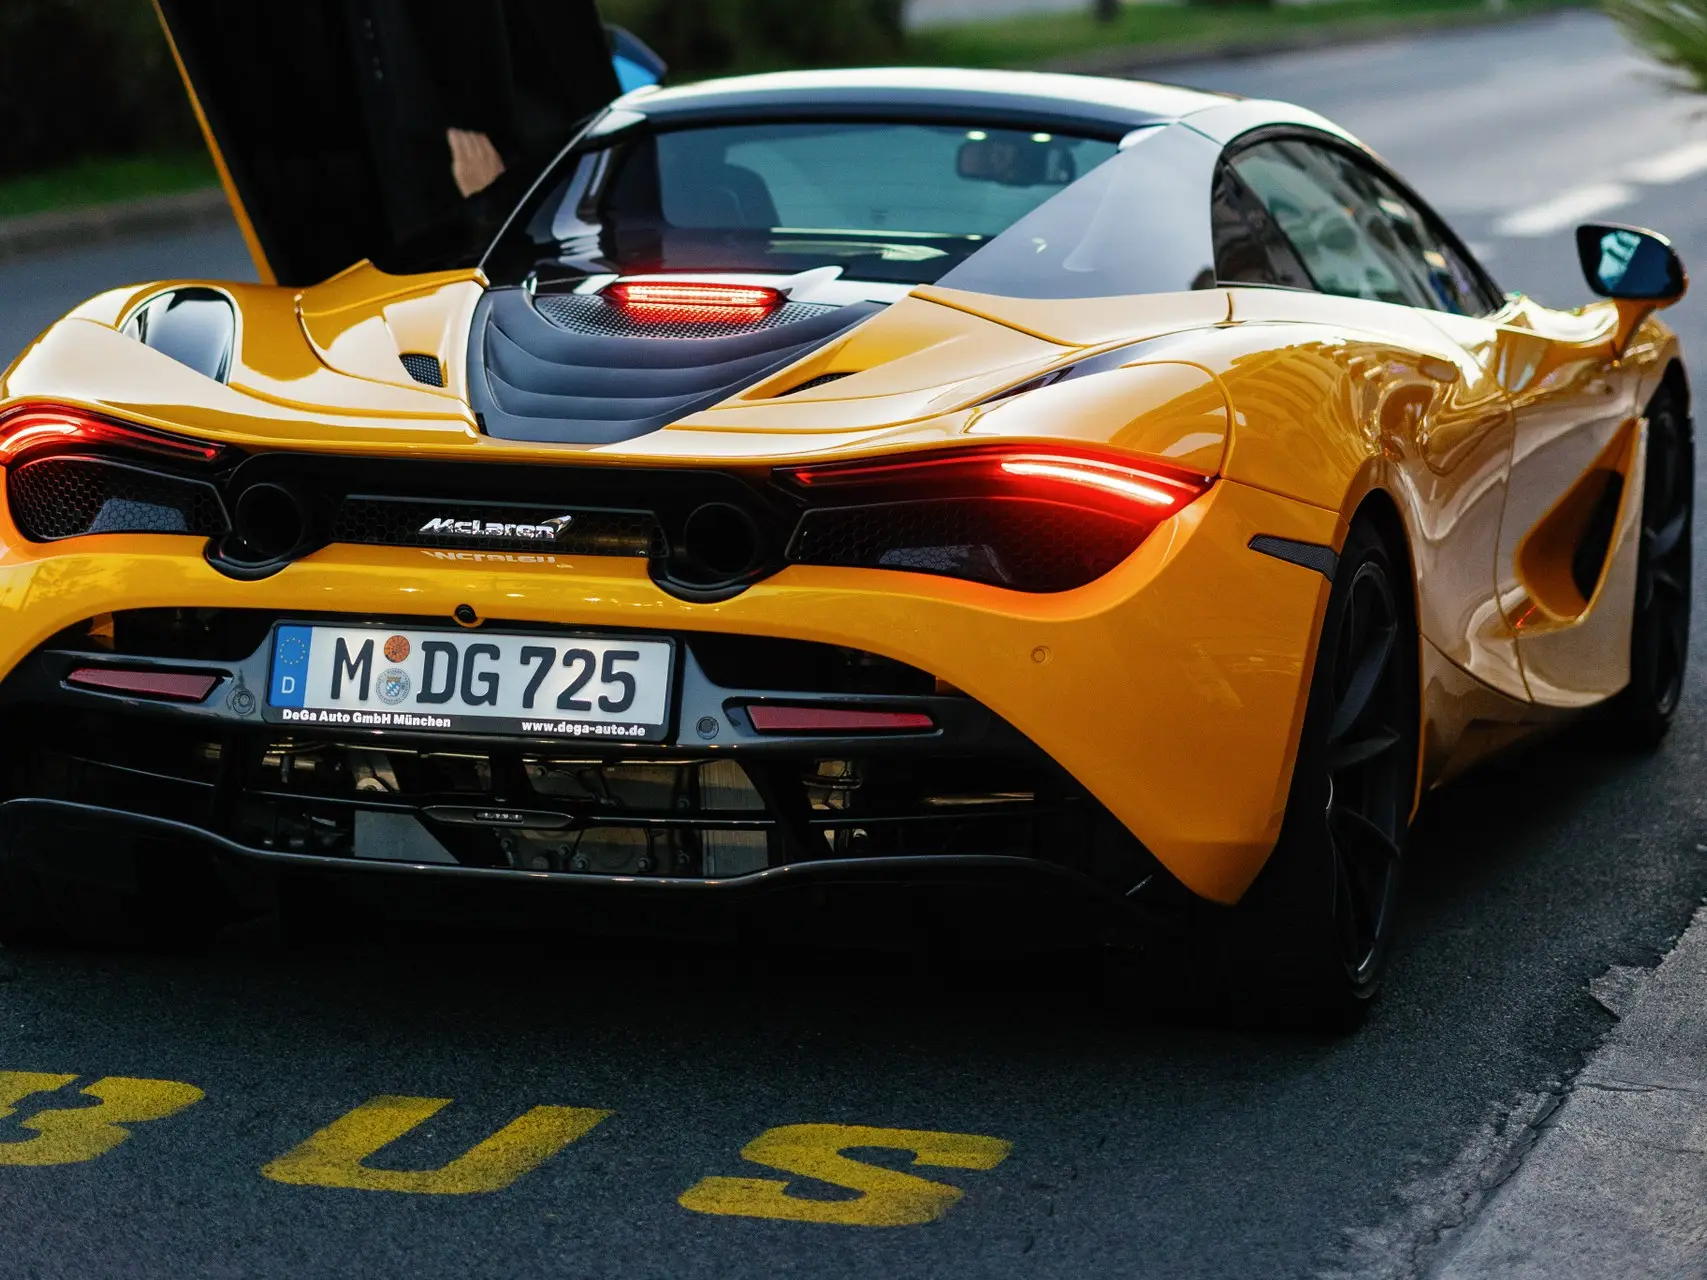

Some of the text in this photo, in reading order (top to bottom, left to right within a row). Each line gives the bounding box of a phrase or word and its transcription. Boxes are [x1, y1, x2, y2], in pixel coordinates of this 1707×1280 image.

[419, 517, 556, 540] McLaren
[330, 636, 375, 701] M
[416, 640, 501, 706] DG
[519, 645, 641, 714] 725
[281, 676, 296, 694] D
[282, 709, 451, 728] DeGa Auto GmbH München
[521, 721, 646, 736] www.dega-auto.de
